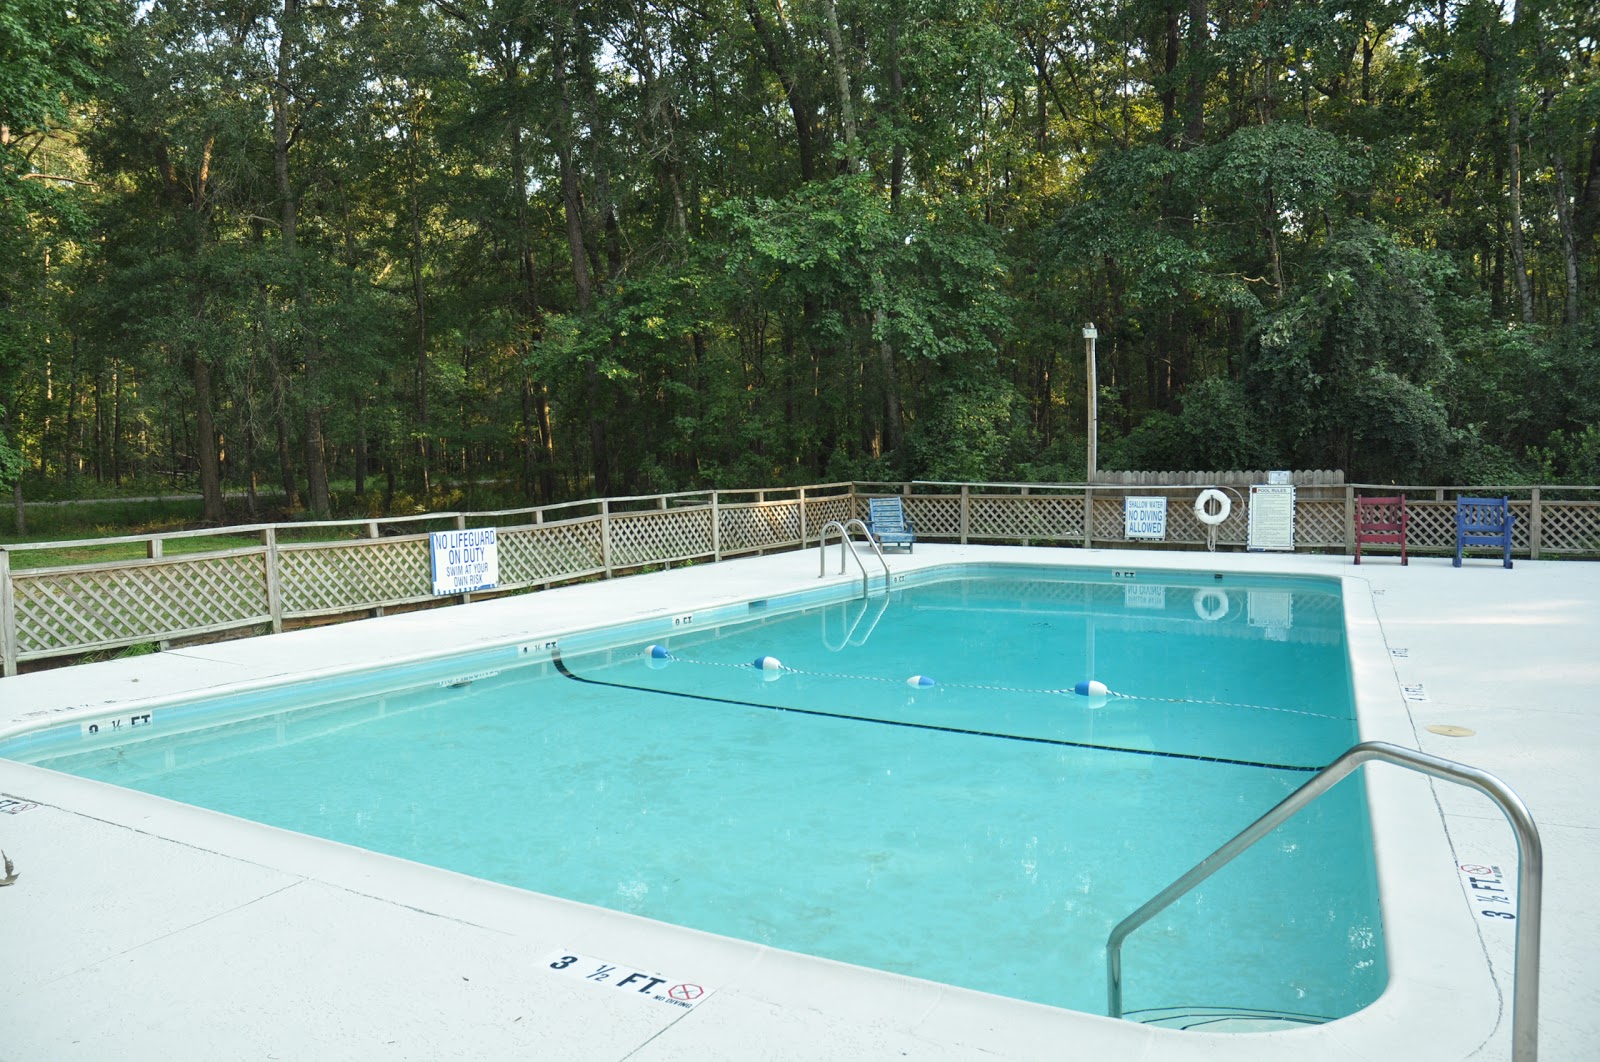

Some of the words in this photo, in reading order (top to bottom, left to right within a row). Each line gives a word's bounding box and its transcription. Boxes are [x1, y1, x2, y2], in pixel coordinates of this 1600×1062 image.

[1129, 510, 1138, 520] NO
[1140, 510, 1162, 521] DIVING
[1129, 522, 1162, 533] ALLOWED
[435, 534, 447, 550] NO
[451, 530, 495, 548] LIFEGUARD
[449, 549, 460, 565] ON
[464, 547, 485, 563] DUTY
[446, 565, 463, 576] SWIM
[465, 564, 472, 574] AT
[474, 563, 488, 573] YOUR
[454, 576, 468, 587] OWN
[470, 574, 483, 585] RISK
[1481, 910, 1515, 920] 3
[550, 956, 578, 969] 3
[616, 973, 667, 995] FT.
[665, 998, 693, 1009] DIVING
